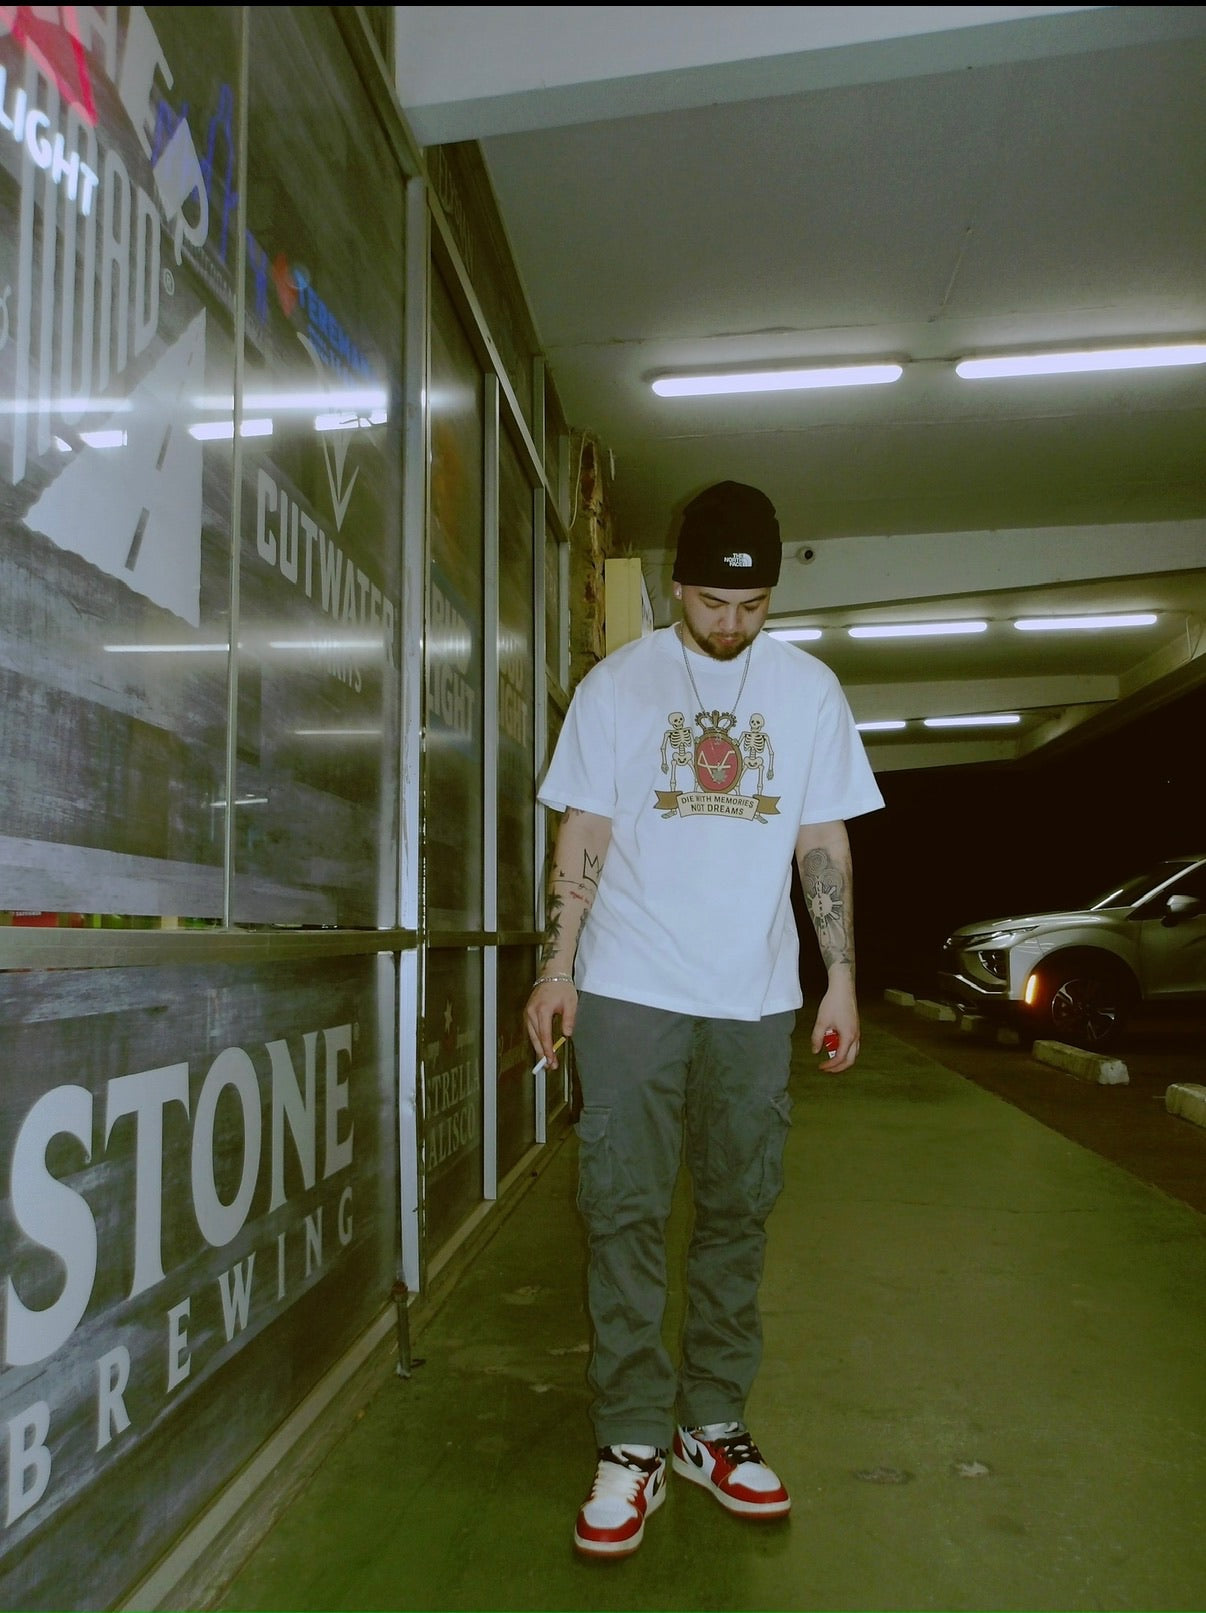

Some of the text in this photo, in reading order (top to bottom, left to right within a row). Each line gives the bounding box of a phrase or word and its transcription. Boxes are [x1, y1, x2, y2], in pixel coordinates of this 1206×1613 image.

[0, 65, 99, 217] LIGHT
[256, 467, 399, 671] CUTWATER
[681, 795, 694, 804] DIE
[713, 795, 755, 809] MEMORIES
[690, 803, 745, 816] NOT DREAMS
[3, 1023, 354, 1367] STONE
[4, 1186, 354, 1530] BREWING
